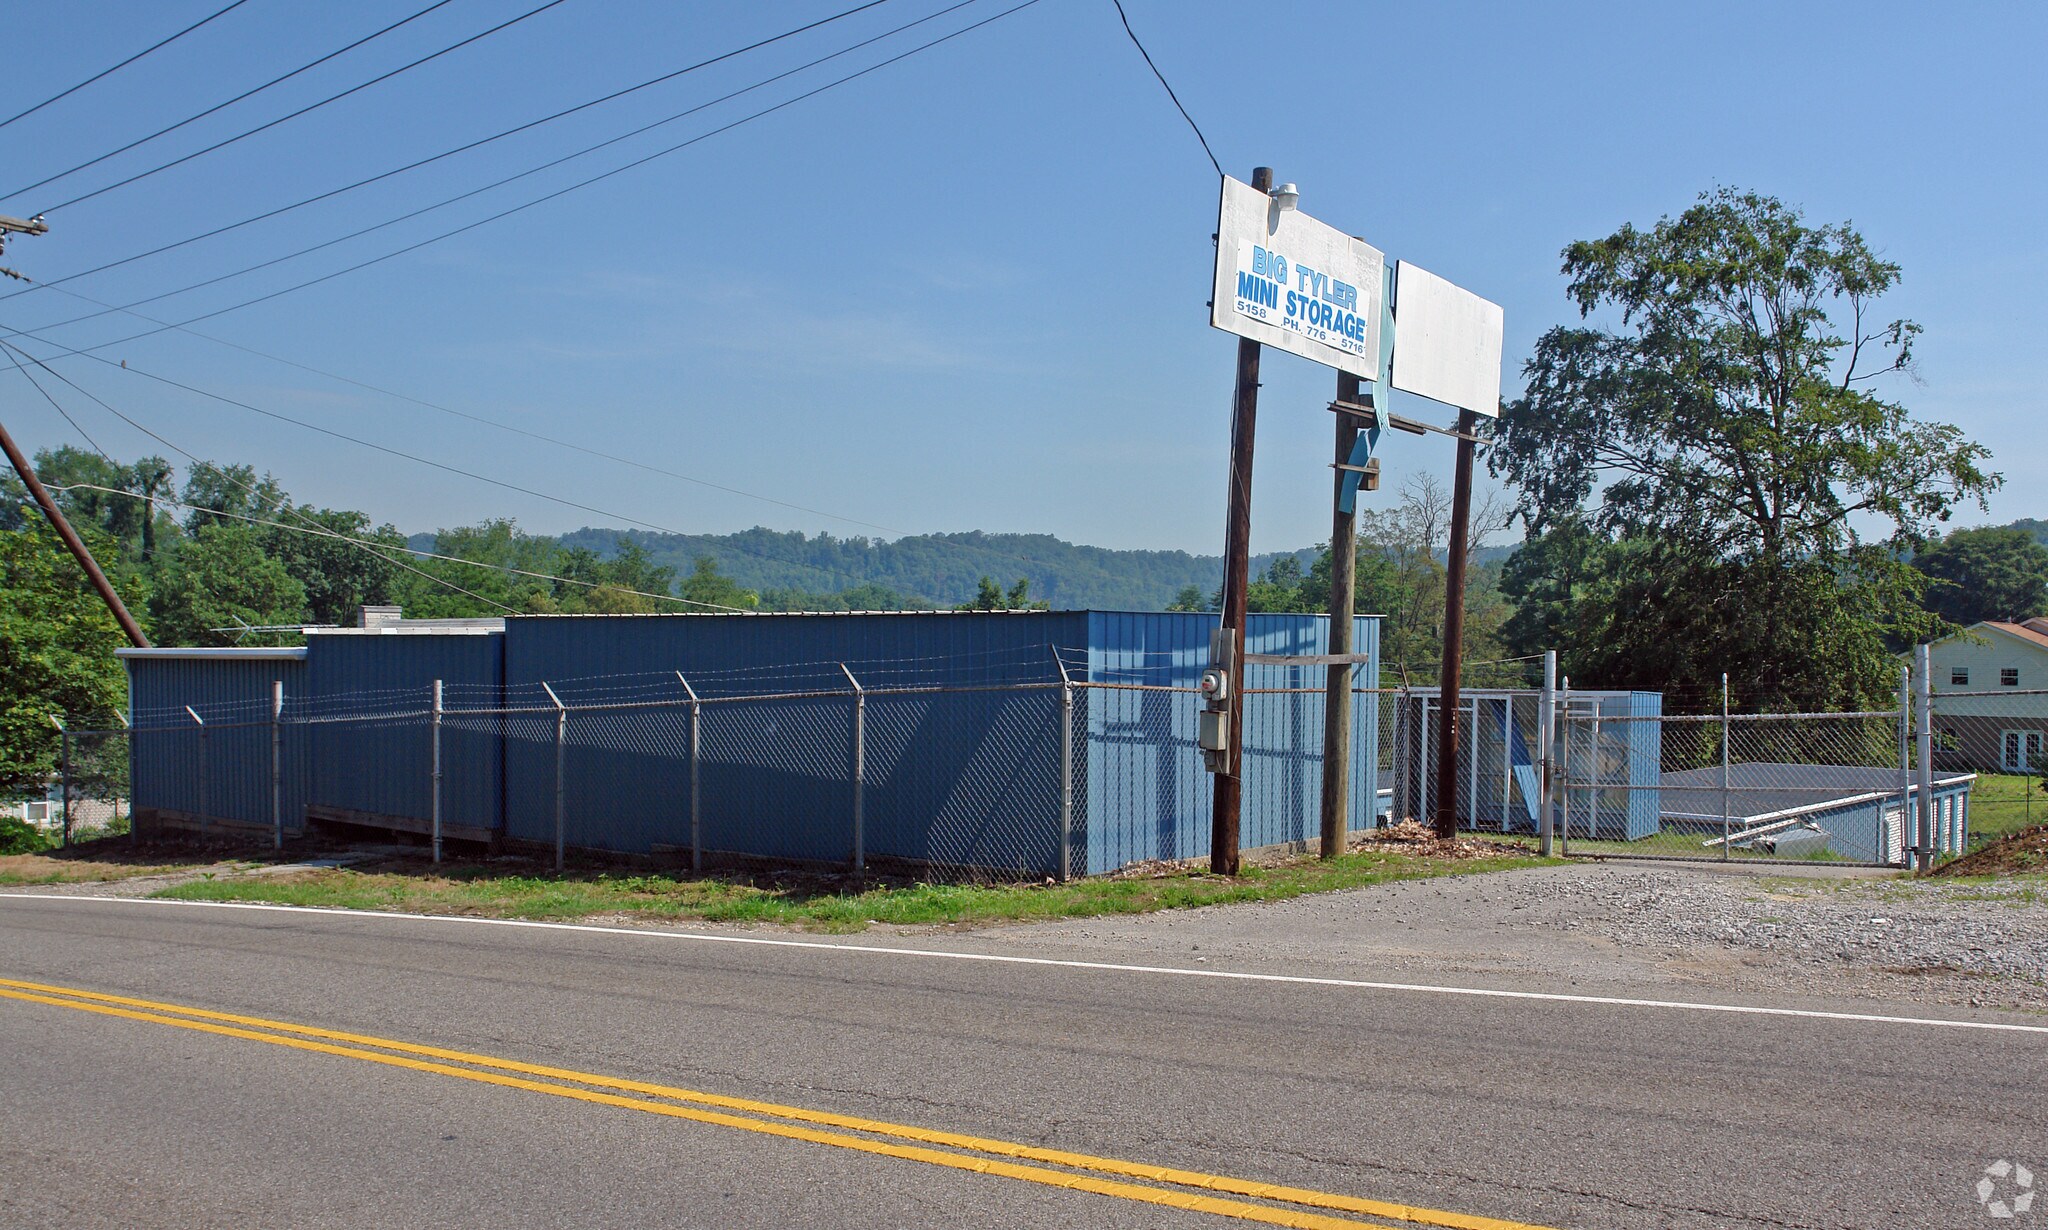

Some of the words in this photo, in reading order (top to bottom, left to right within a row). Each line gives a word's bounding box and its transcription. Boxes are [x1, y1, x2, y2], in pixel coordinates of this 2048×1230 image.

[1237, 270, 1278, 310] MINI
[1285, 290, 1365, 343] STORAGE
[1252, 245, 1287, 285] BIG
[1296, 263, 1357, 313] TYLER
[1237, 300, 1267, 319] 5158
[1283, 317, 1301, 332] PH.
[1307, 326, 1326, 341] 776
[1341, 338, 1363, 354] 5716
